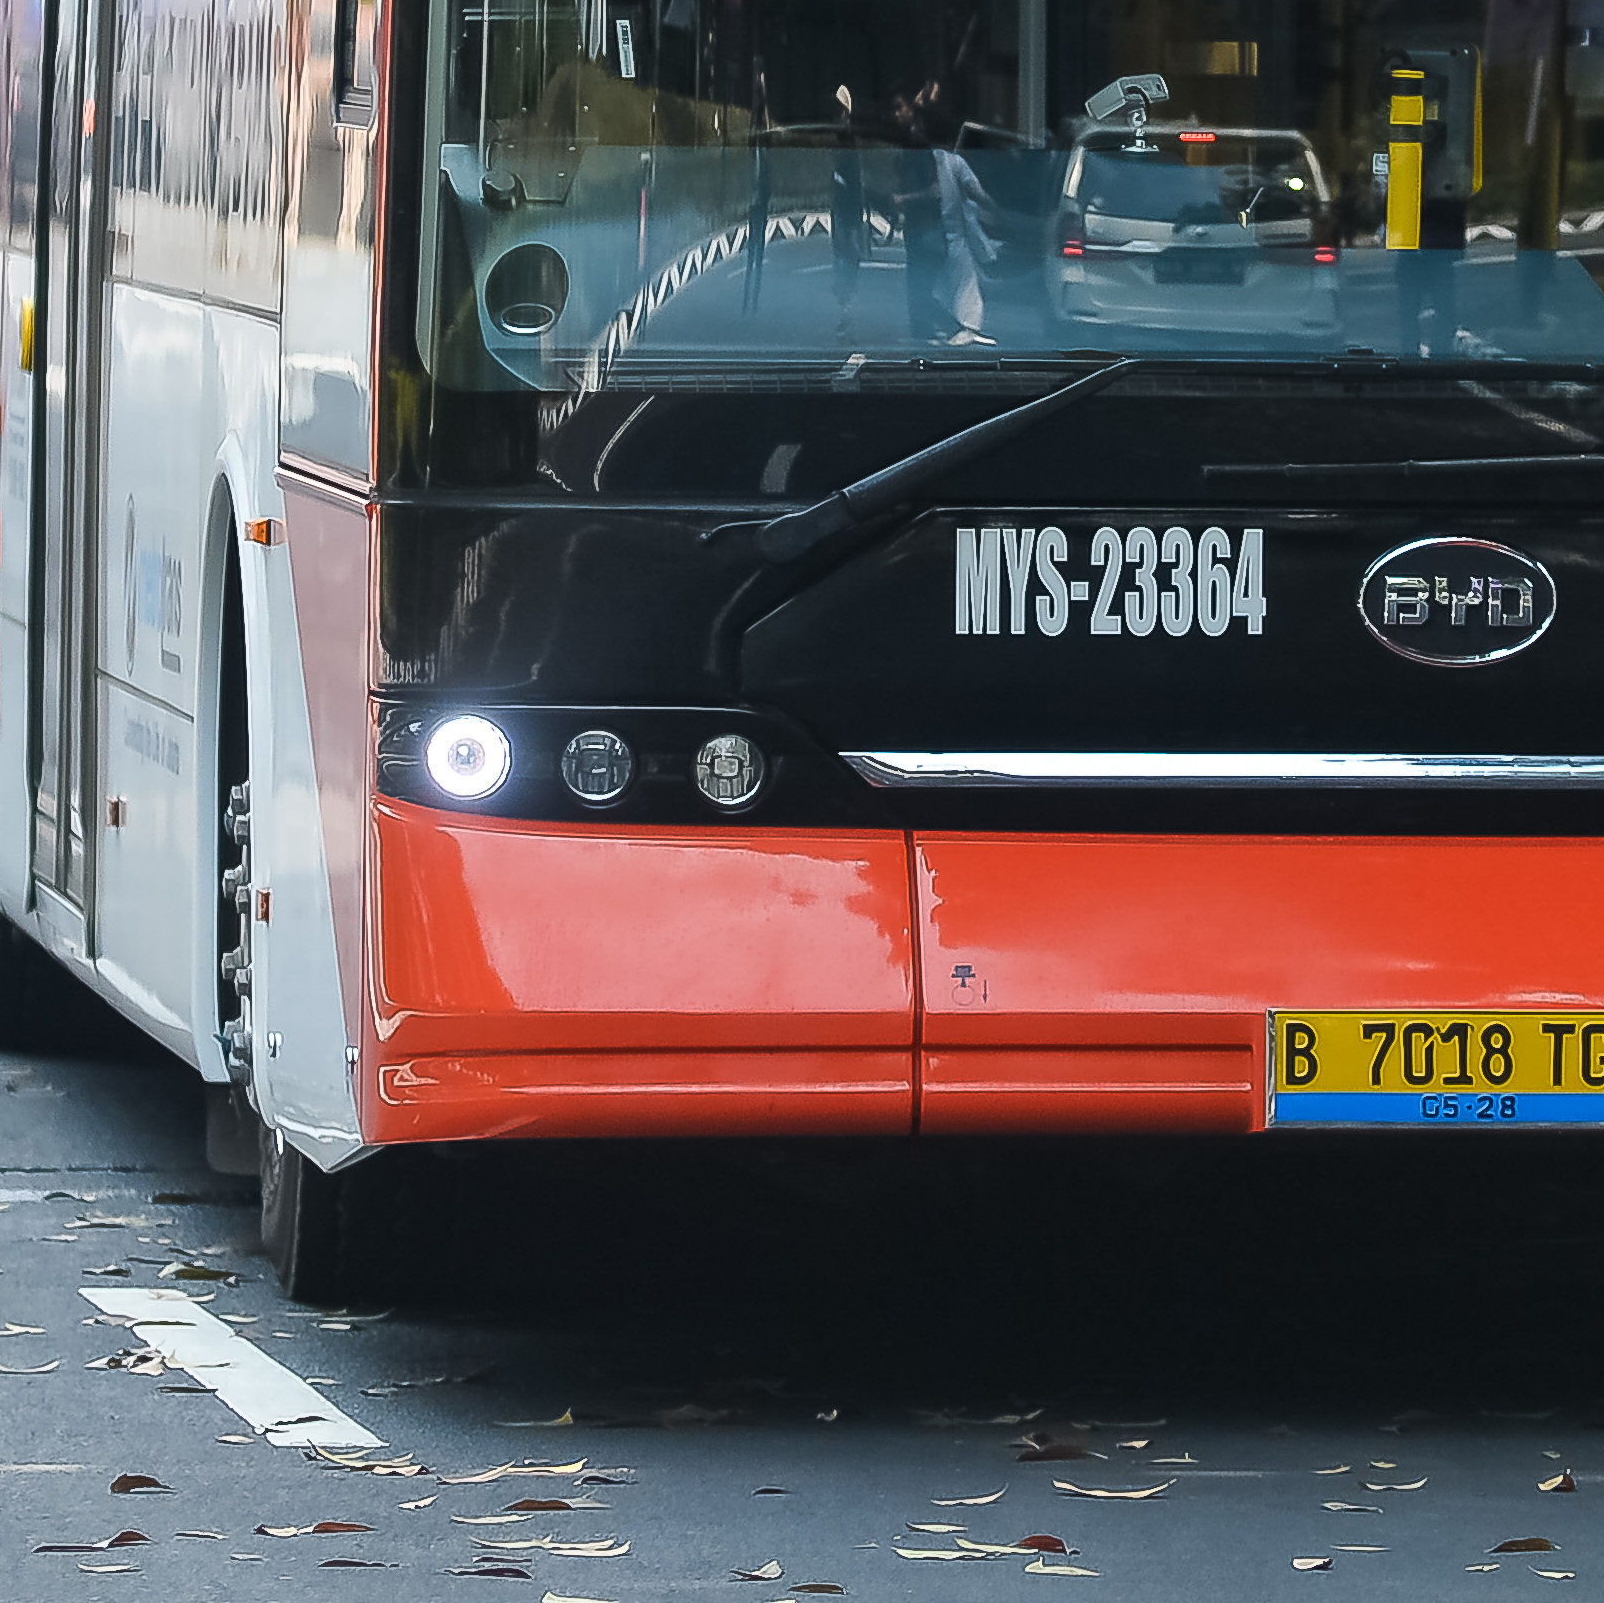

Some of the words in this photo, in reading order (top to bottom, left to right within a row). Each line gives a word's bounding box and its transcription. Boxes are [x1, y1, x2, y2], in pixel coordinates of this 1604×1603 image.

[955, 526, 1267, 637] MYS-23364
[1384, 575, 1535, 628] BYD
[1285, 1021, 1319, 1086] B
[1360, 1021, 1514, 1087] 7018
